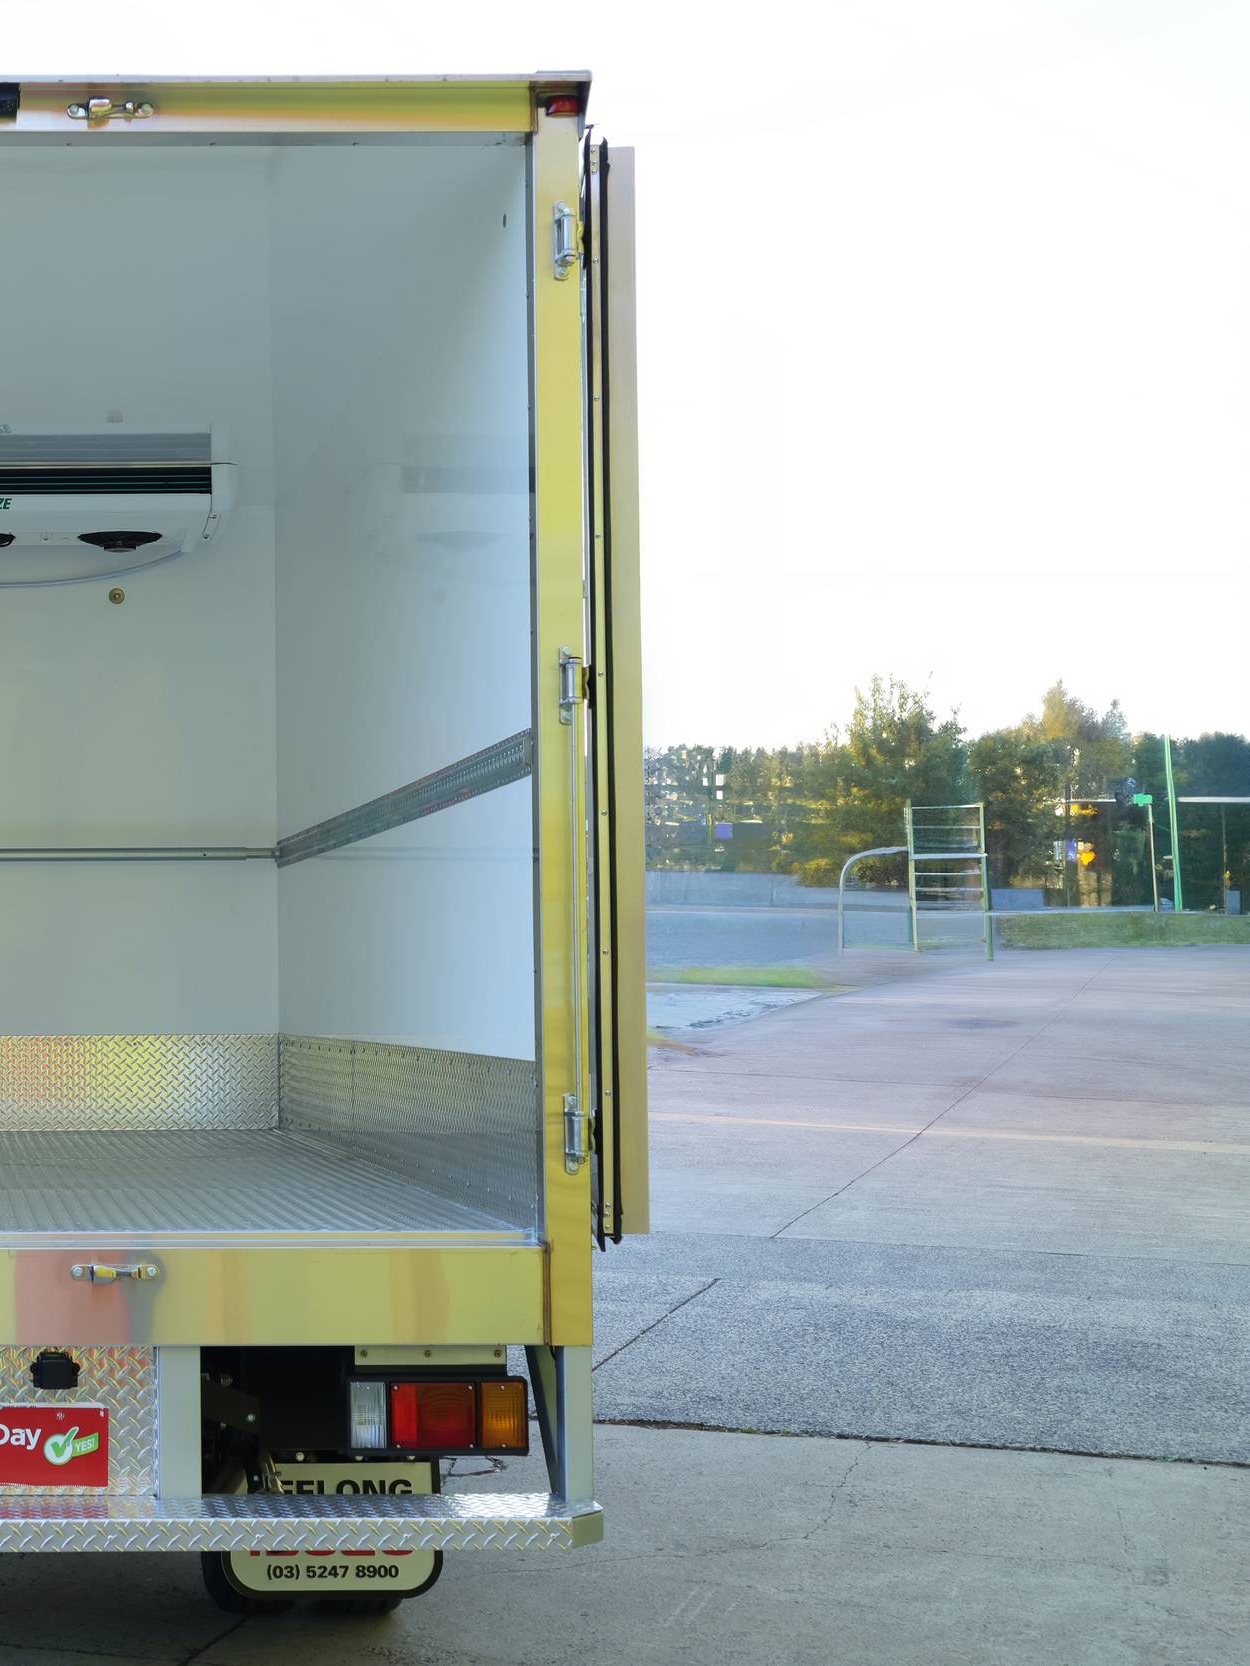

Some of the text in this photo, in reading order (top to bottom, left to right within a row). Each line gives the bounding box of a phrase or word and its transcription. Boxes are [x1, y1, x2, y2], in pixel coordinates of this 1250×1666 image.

[75, 1439, 95, 1452] YES!
[267, 1564, 399, 1580] (03) 5247 8900
